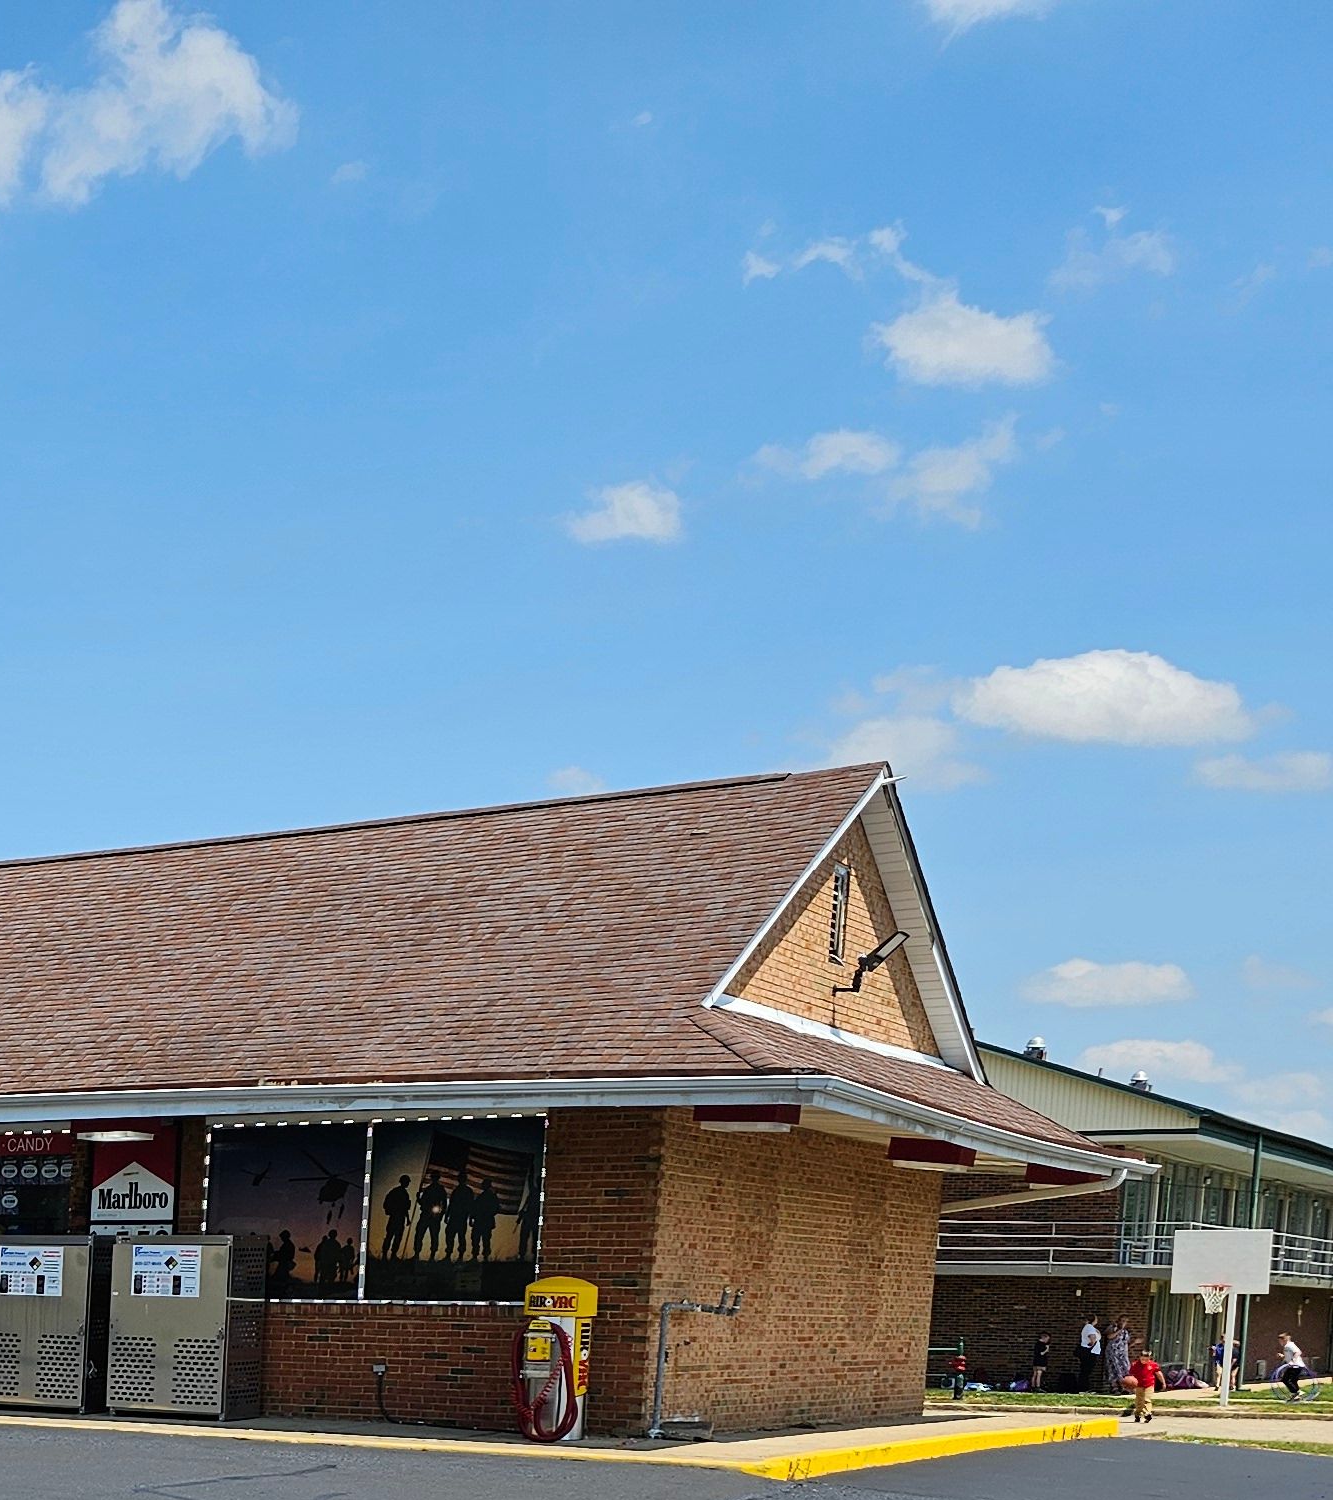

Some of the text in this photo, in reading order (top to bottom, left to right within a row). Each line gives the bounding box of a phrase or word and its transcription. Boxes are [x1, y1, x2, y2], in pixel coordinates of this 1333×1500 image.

[7, 1137, 55, 1152] CANDY
[97, 1181, 169, 1210] Marlboro
[530, 1295, 577, 1309] AIR VAC
[578, 1360, 590, 1390] VAC
